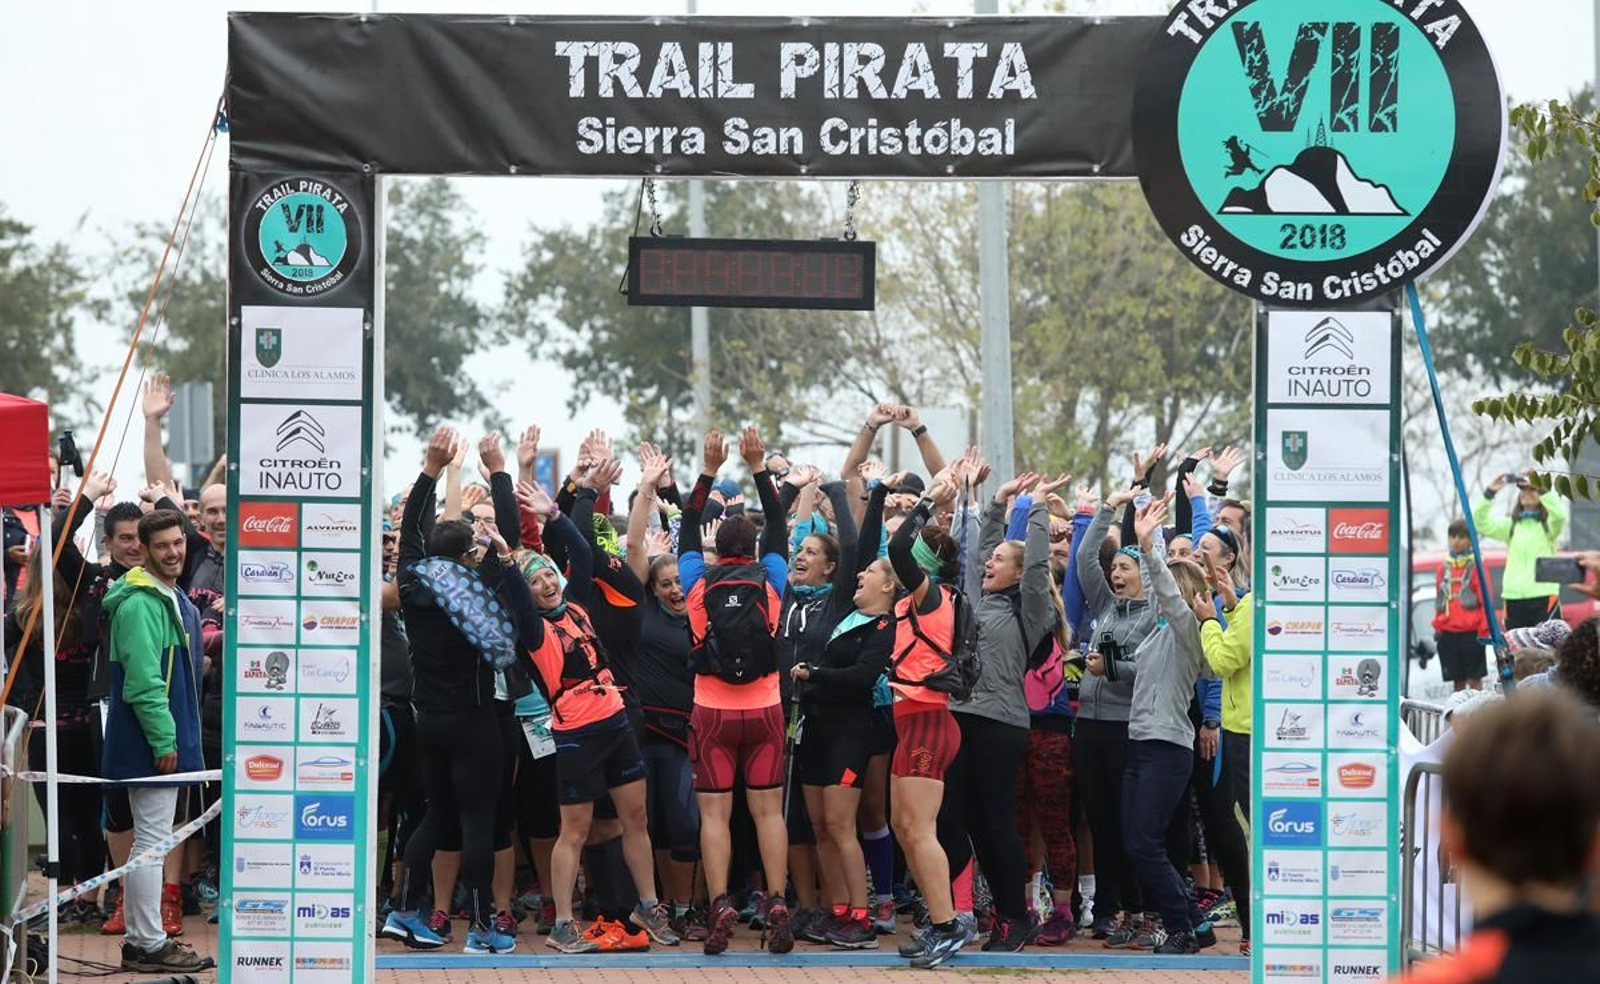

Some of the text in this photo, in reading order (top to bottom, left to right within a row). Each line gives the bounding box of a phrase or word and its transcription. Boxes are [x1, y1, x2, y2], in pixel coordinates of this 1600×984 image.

[554, 41, 1038, 99] TRAIL PIRATA
[1231, 21, 1401, 133] VII
[576, 117, 1016, 156] Sierra San Cristóbal
[255, 180, 349, 214] TRAIL PIRATA
[280, 203, 325, 234] VII
[1279, 223, 1347, 250] 2018
[291, 268, 315, 278] 2018
[1180, 224, 1443, 300] Sierra San Cristóbal
[260, 267, 284, 289] Sierra
[285, 282, 304, 294] San
[290, 370, 312, 380] LOS
[1287, 379, 1372, 397] INAUTO
[259, 471, 342, 491] INAUTO
[1317, 472, 1338, 482] LOS
[237, 956, 283, 967] RUNNEK
[1334, 965, 1380, 975] RUNNEK
